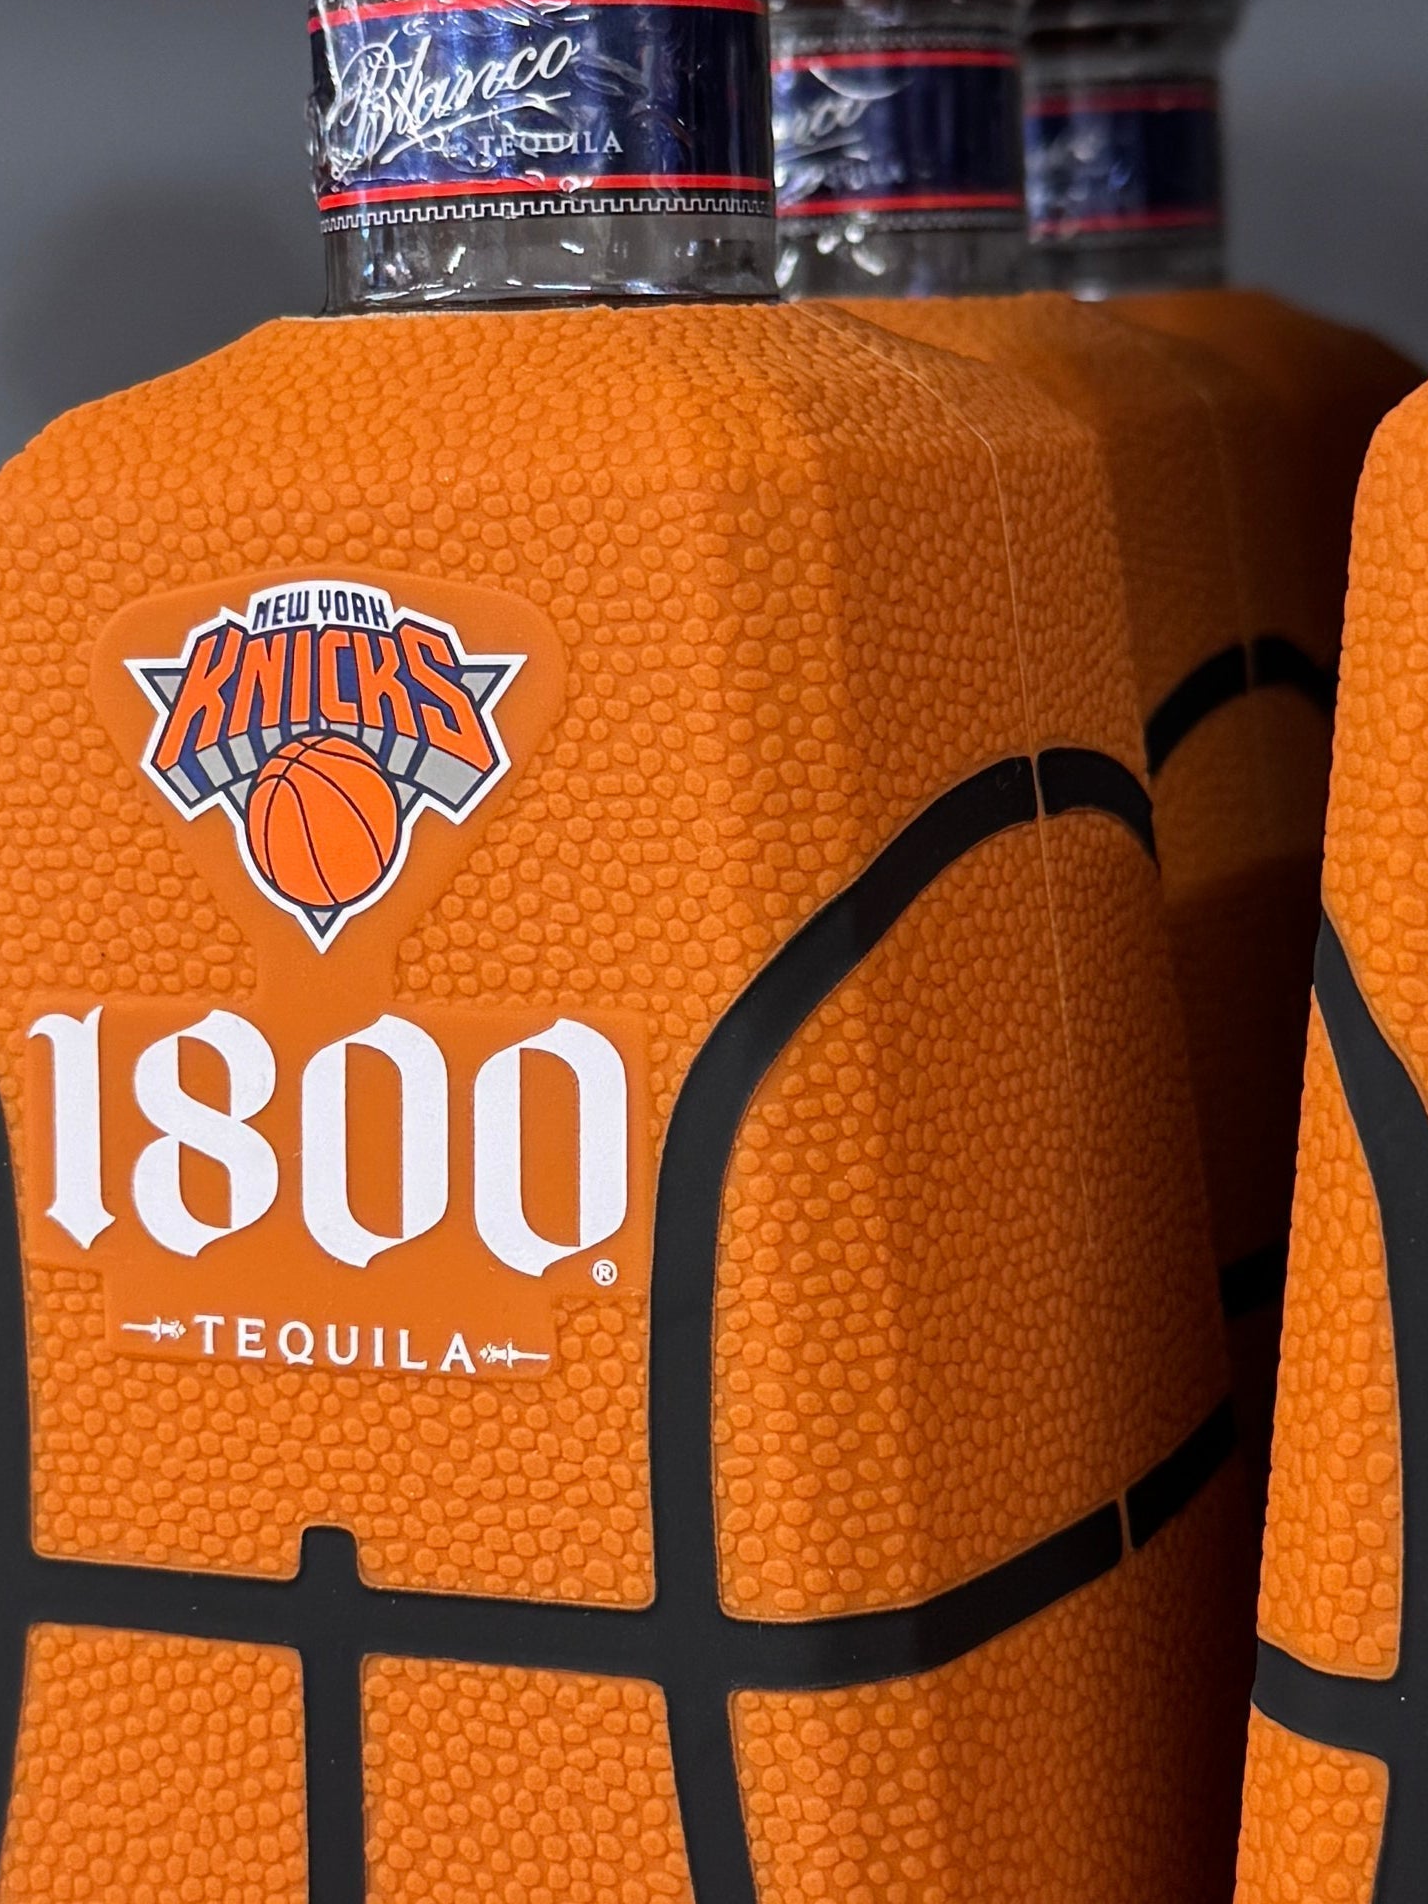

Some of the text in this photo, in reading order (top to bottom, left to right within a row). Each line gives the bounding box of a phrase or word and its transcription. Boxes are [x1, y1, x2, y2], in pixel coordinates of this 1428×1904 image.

[327, 30, 580, 162] Blanco
[477, 129, 624, 159] TEQUILA
[252, 589, 389, 631] NEW YORK
[156, 623, 495, 772] KNICKS
[28, 1005, 628, 1277] 1800
[194, 1313, 477, 1374] TEQUILA
